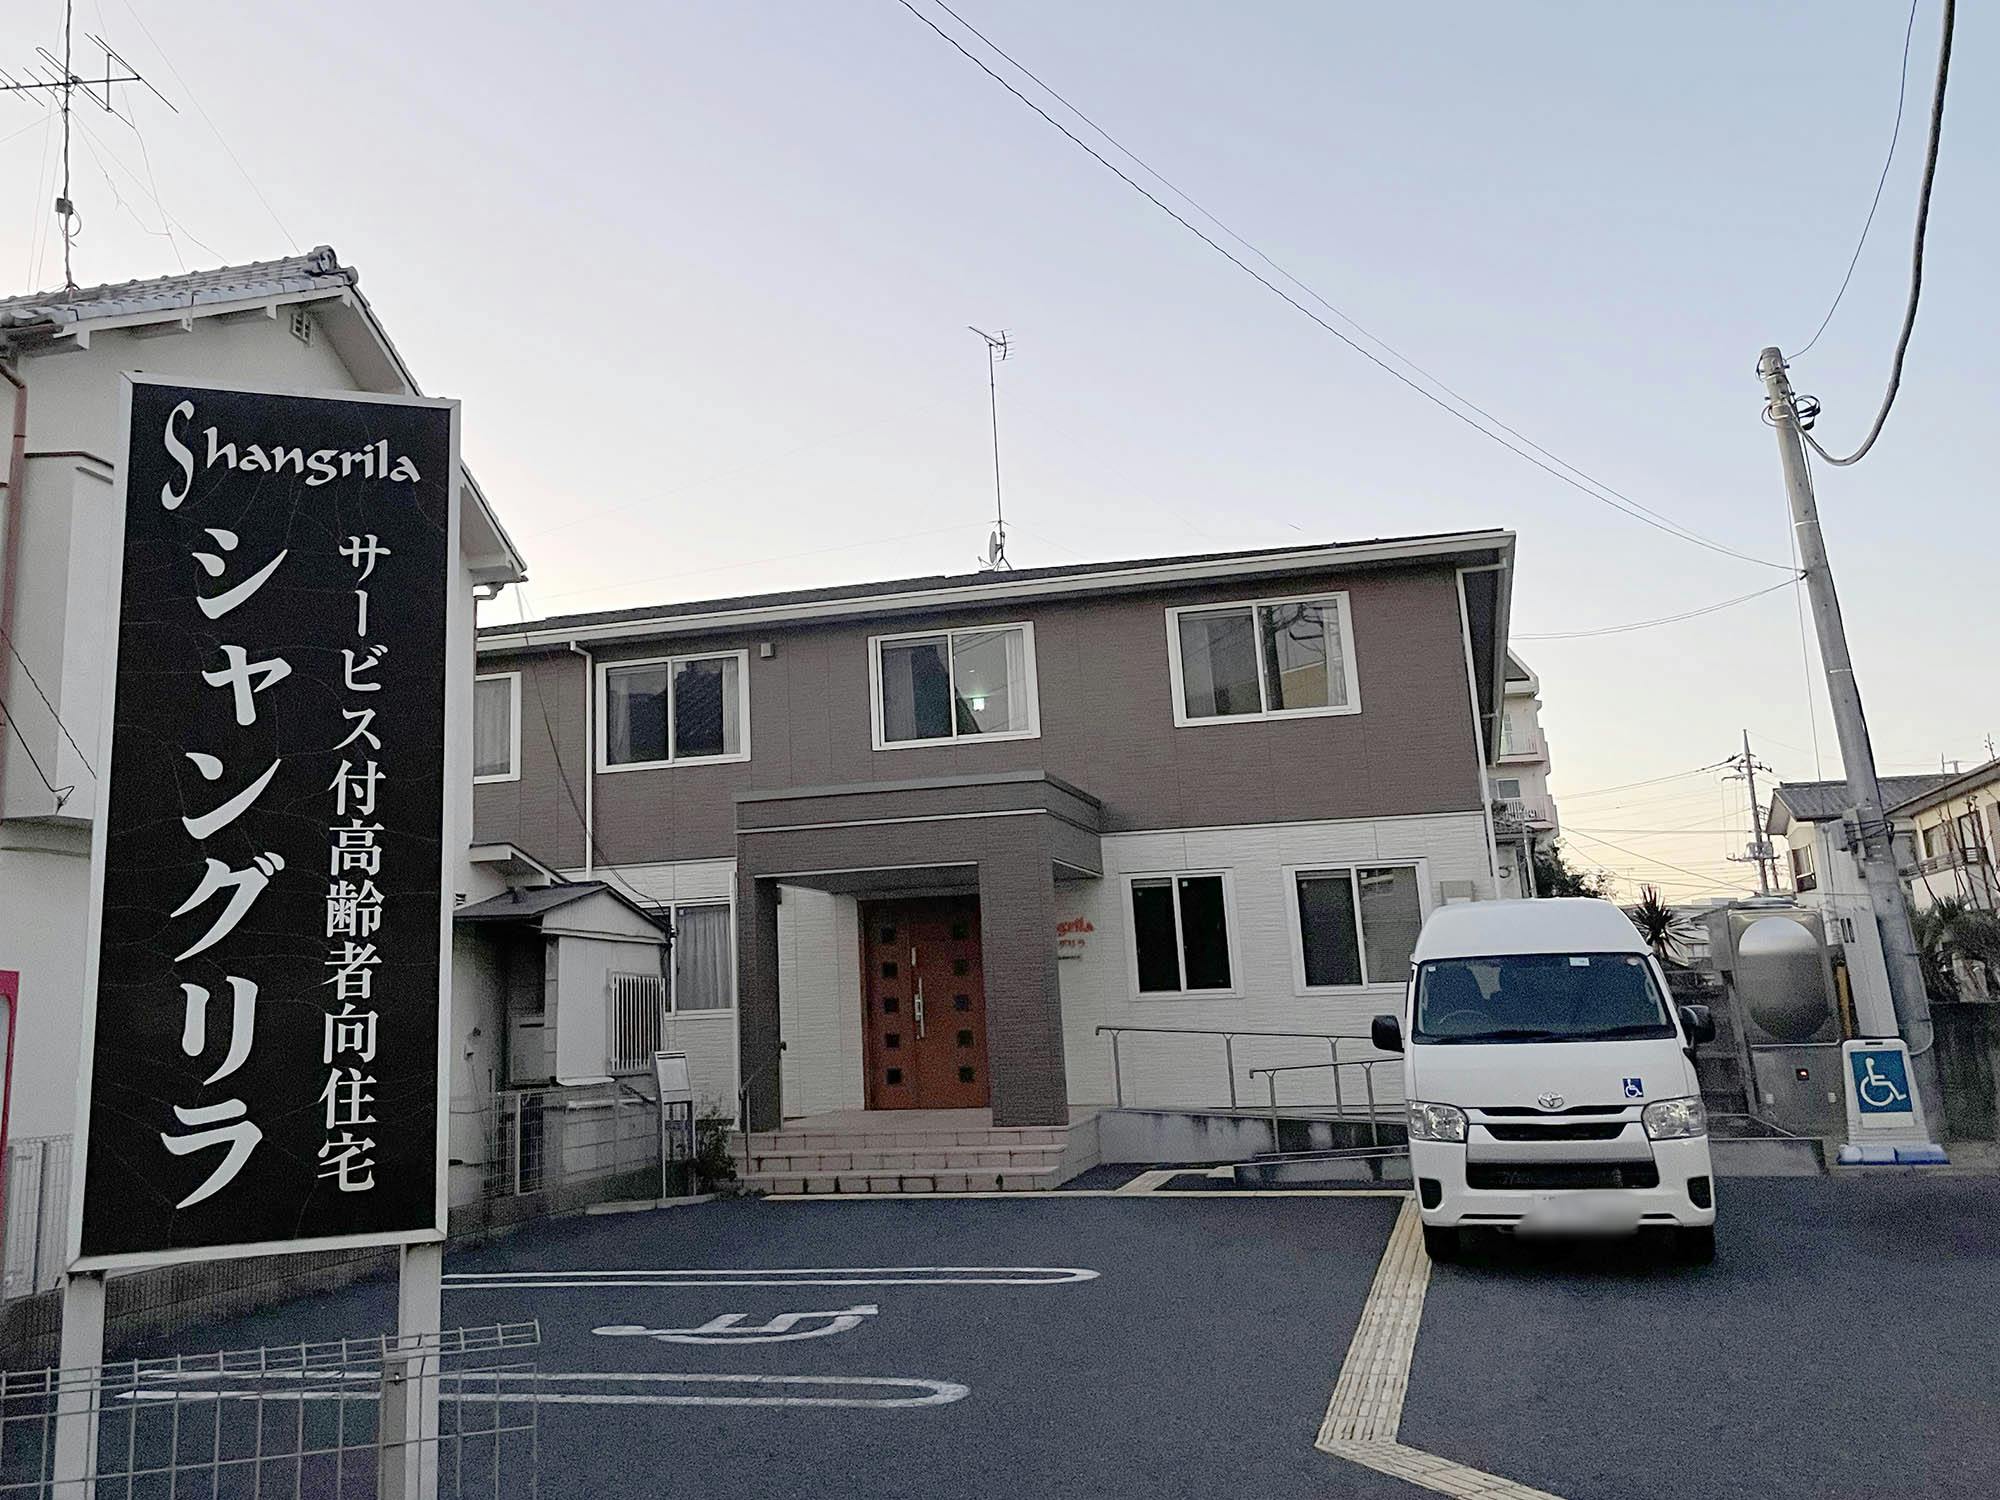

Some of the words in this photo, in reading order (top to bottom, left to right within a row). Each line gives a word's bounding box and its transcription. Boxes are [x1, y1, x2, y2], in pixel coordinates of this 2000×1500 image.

[161, 400, 421, 510] Shangrila
[160, 528, 293, 1210] シャングリラ
[317, 534, 391, 1192] サービス付高齢者向住宅
